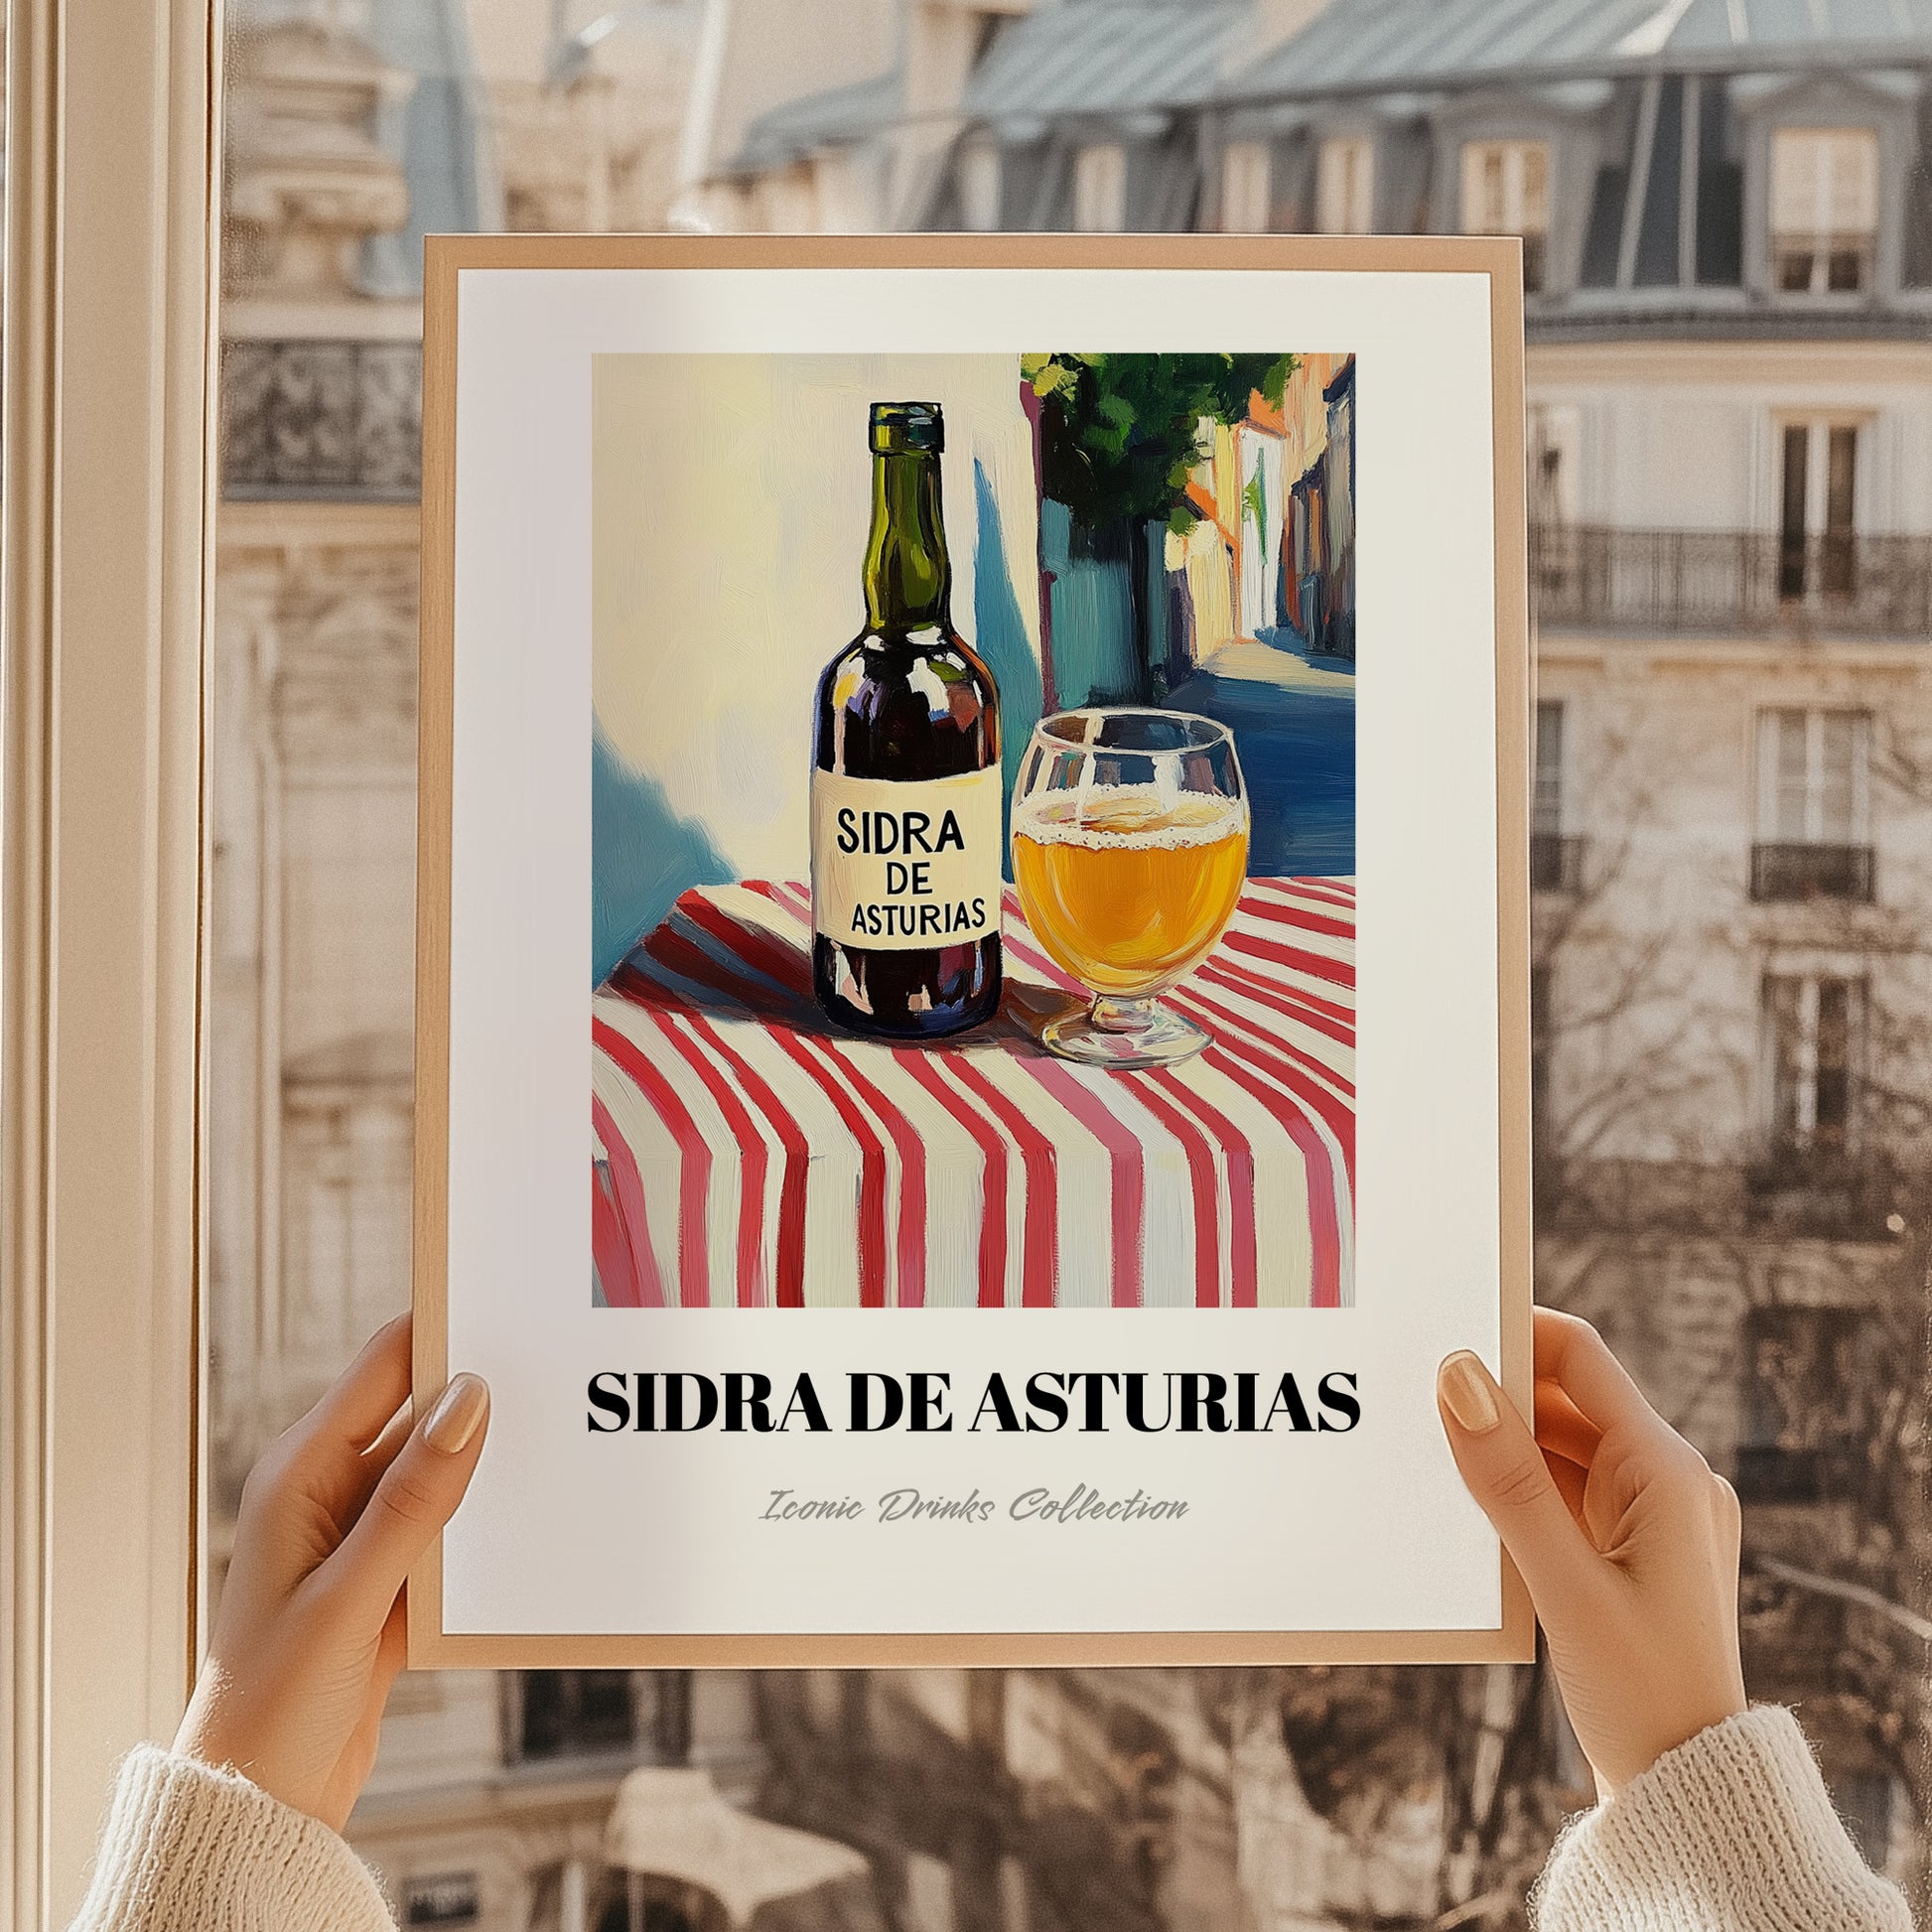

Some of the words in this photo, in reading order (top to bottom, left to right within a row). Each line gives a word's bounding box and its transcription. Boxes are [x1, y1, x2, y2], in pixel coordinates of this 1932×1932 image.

[837, 807, 965, 855] SIDRA
[887, 862, 933, 896] DE
[851, 897, 986, 936] ASTURIAS
[587, 1372, 832, 1433] SIDRA
[846, 1372, 953, 1433] DE
[968, 1372, 1361, 1433] ASTURIAS
[759, 1488, 866, 1522] Iconic
[878, 1487, 996, 1524] Drinks
[1009, 1481, 1190, 1524] Collection
